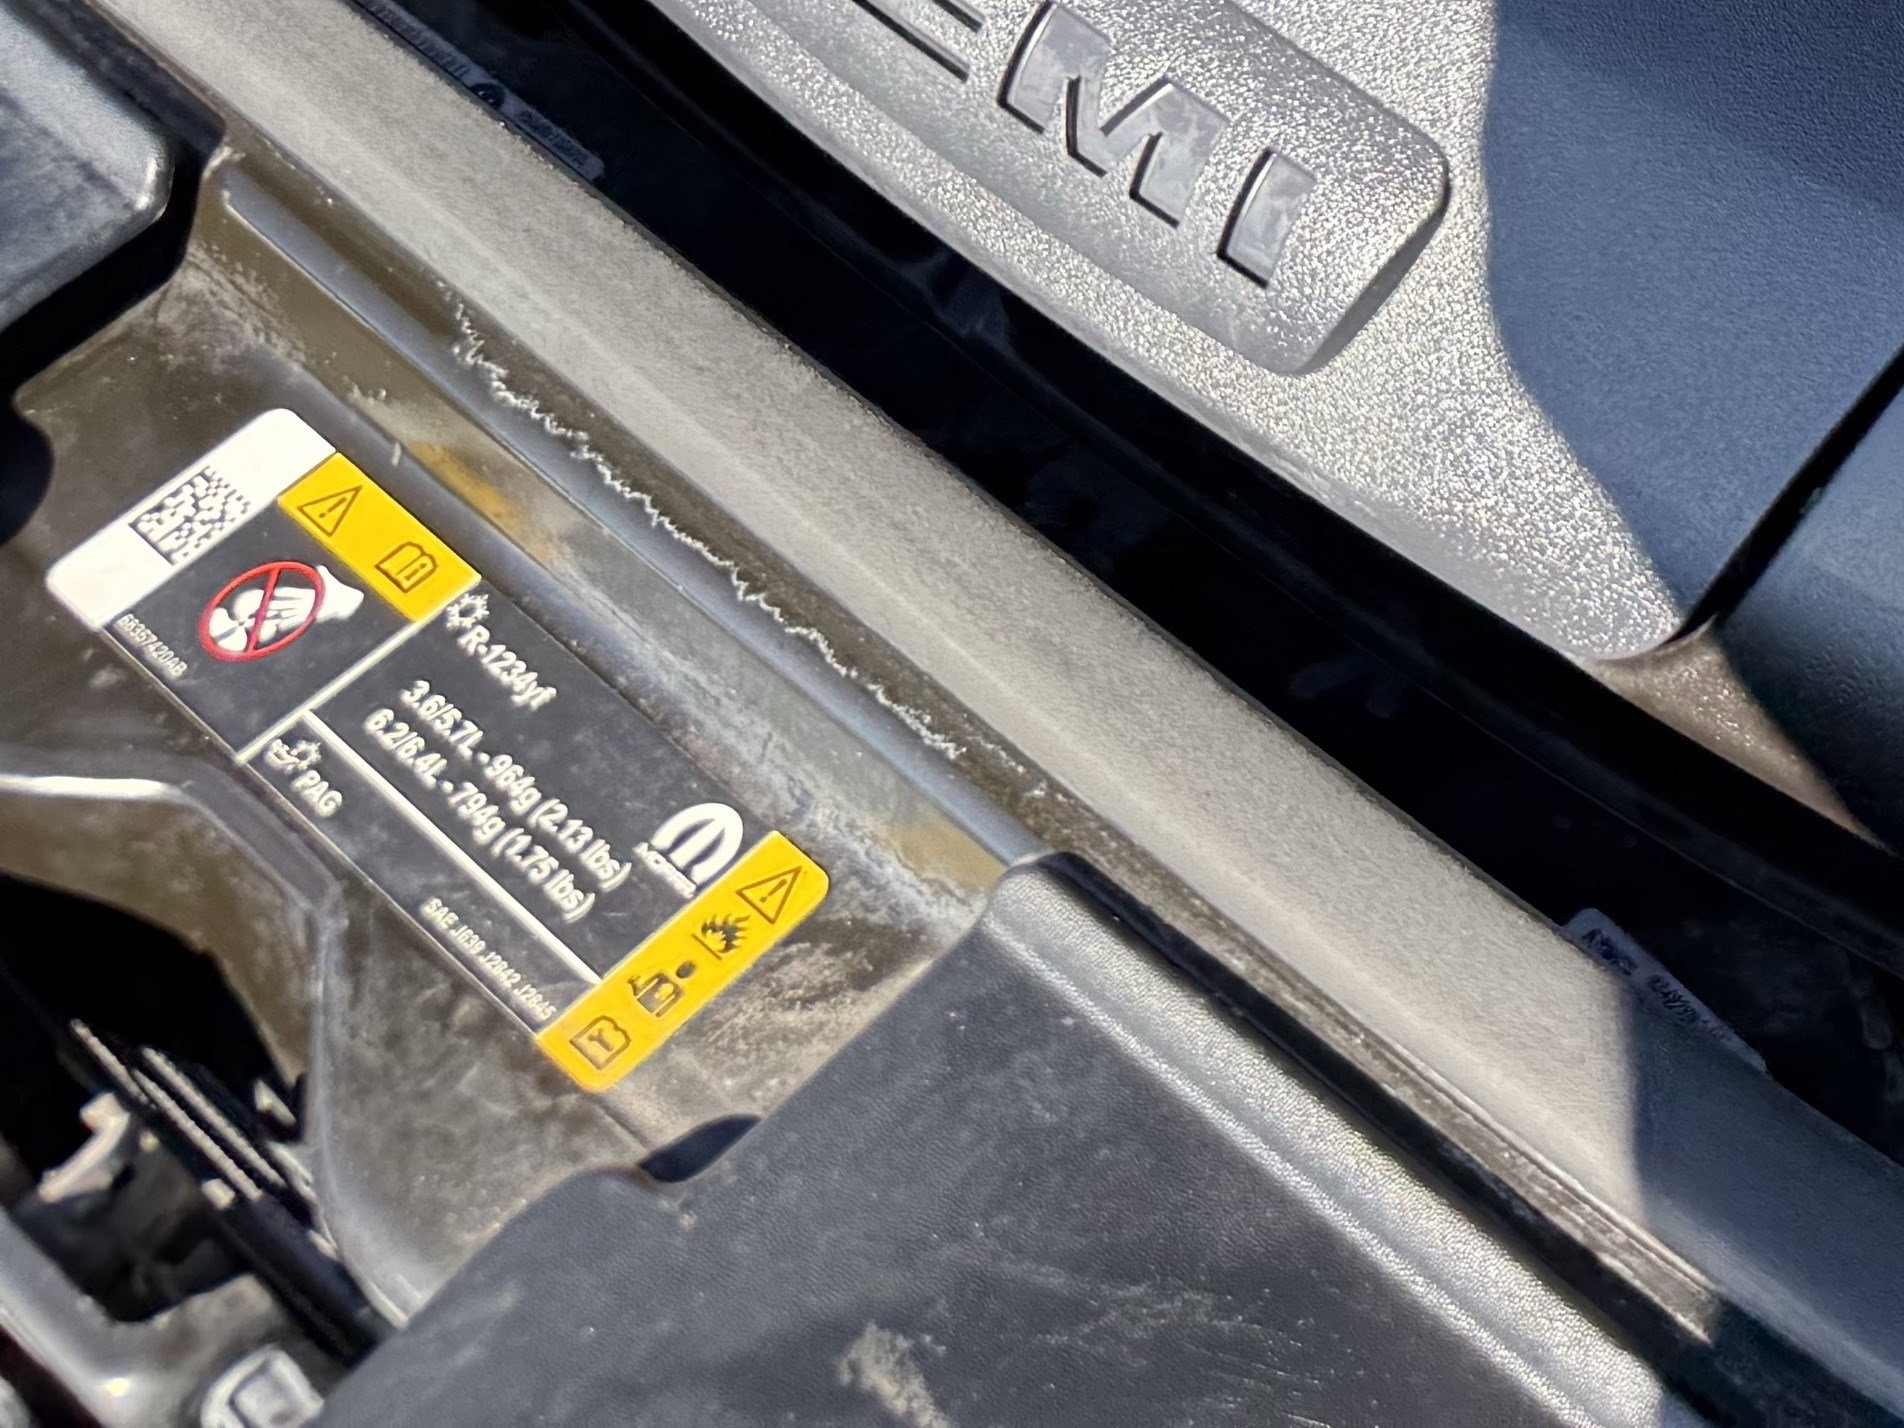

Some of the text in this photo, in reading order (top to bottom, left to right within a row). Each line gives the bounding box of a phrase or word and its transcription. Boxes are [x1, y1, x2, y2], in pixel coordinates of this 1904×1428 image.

[457, 625, 557, 712] R-1234yf
[291, 769, 343, 818] PAG
[363, 708, 448, 791] 6.2/6.4L
[448, 781, 506, 846] 794g
[489, 827, 560, 886] (1.75
[543, 869, 596, 923] lbs)
[401, 680, 484, 761] 3.6/5.7L
[483, 754, 542, 817] 964g
[527, 798, 594, 855] (2.13
[578, 839, 633, 892] lbs)
[420, 897, 460, 930] SAE
